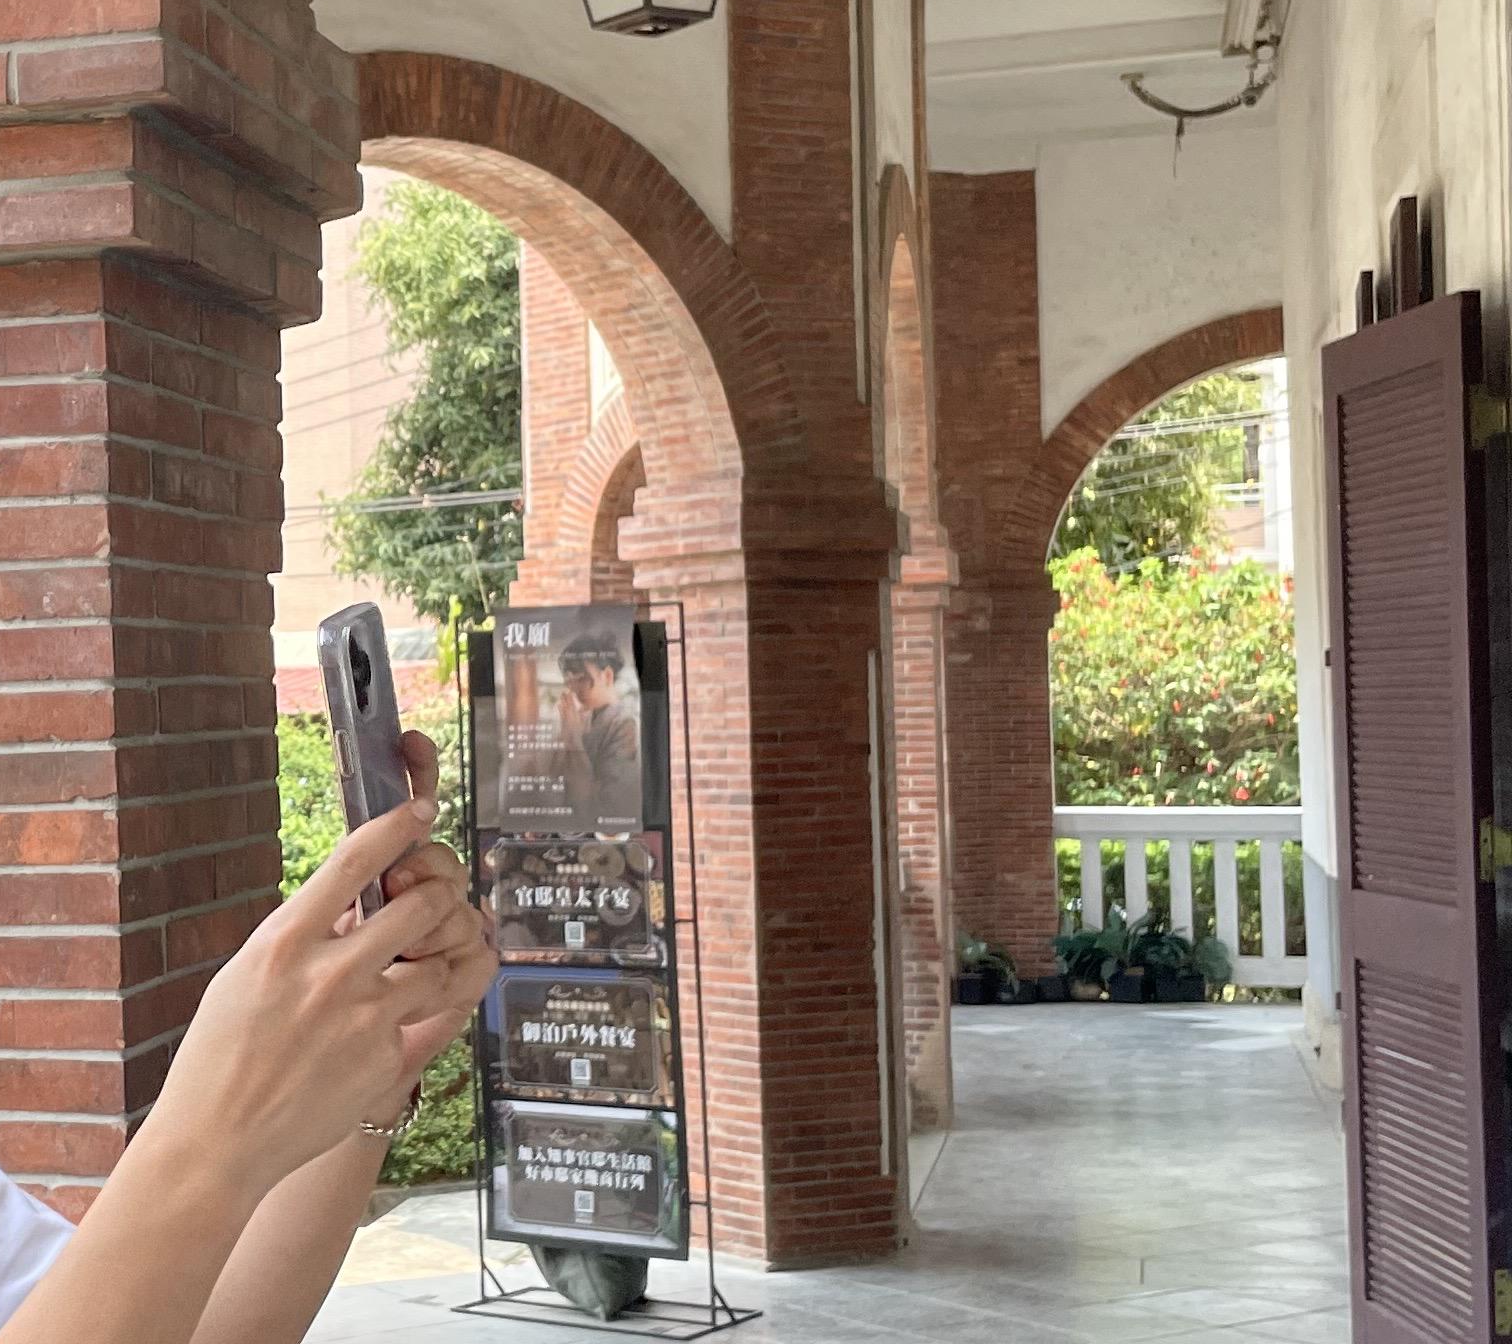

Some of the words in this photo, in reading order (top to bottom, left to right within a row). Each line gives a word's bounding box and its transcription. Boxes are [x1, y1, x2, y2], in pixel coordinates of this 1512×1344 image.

[503, 622, 551, 648] 我願
[515, 885, 630, 909] 官邸皇太子宴
